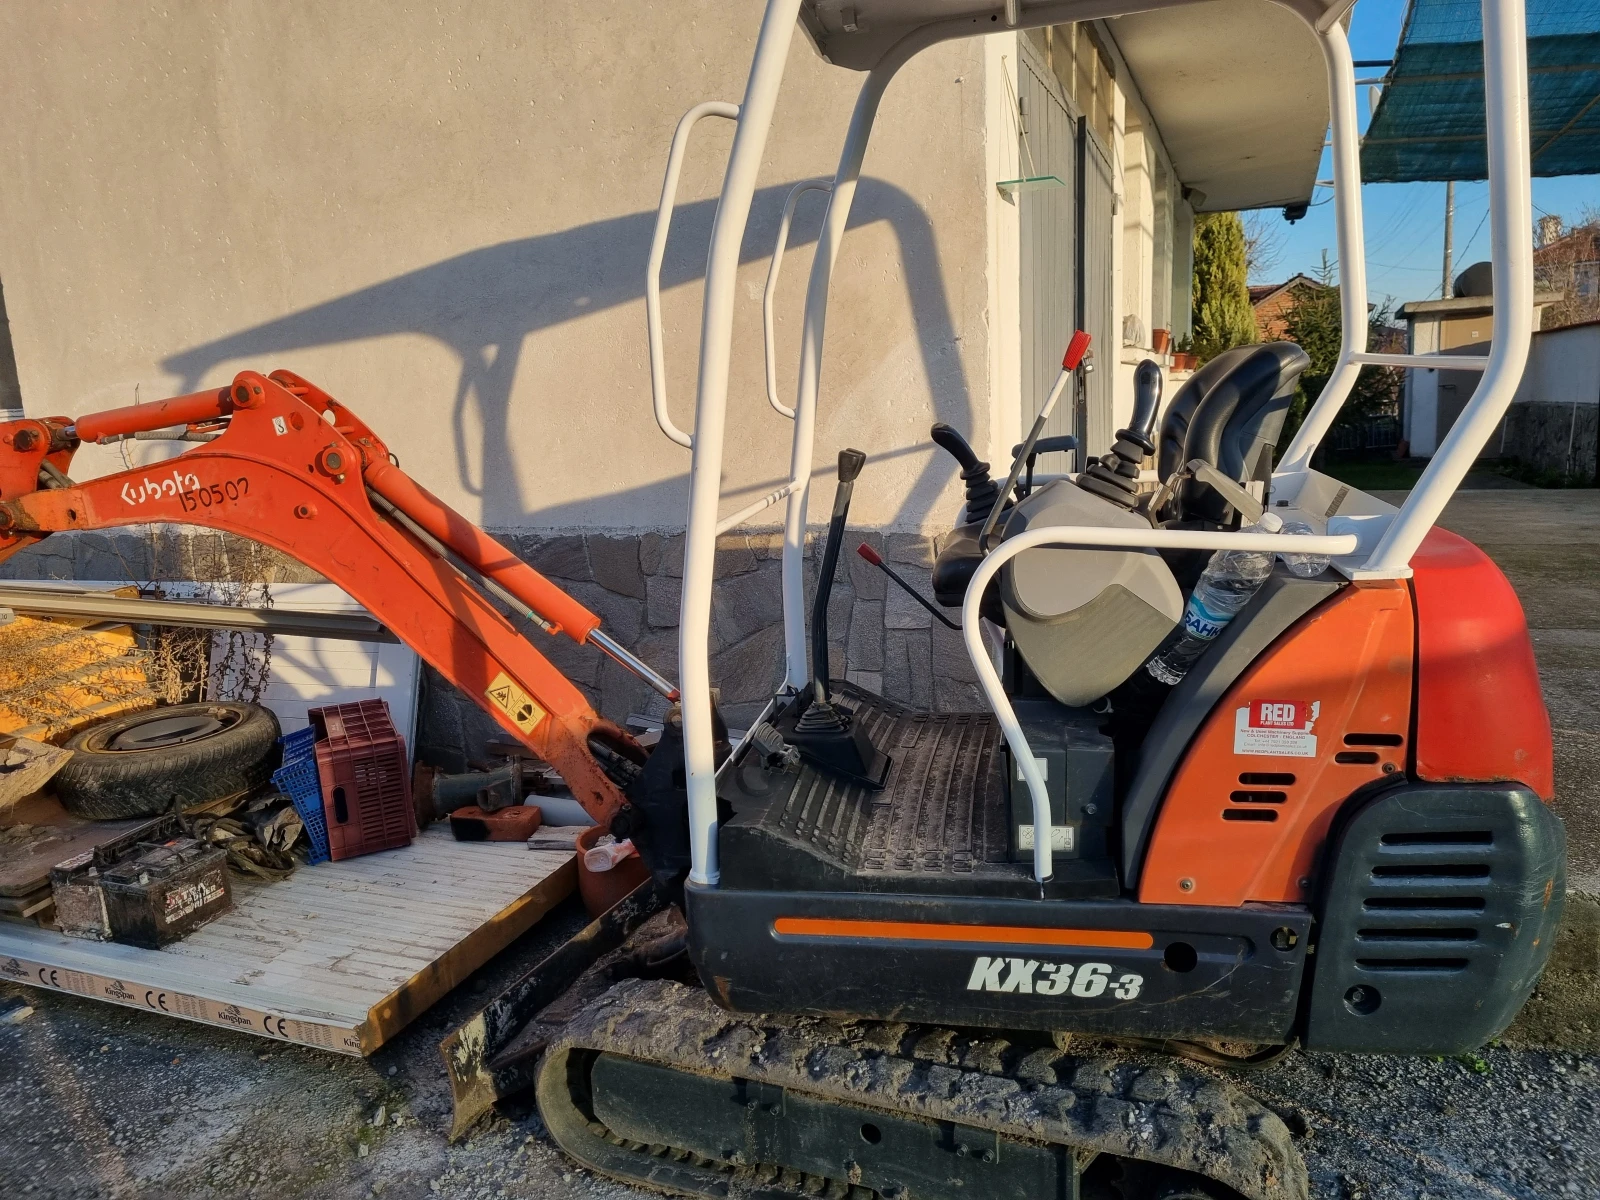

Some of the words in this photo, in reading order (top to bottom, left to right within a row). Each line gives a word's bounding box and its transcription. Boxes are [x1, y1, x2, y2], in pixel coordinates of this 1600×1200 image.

[121, 471, 200, 505] Kubota
[1260, 703, 1296, 722] RED
[39, 967, 60, 987] CE
[967, 956, 1144, 1000] KX36-3
[104, 986, 135, 1000] Kingspan
[145, 991, 169, 1012] CE
[218, 1011, 252, 1026] Kingspan
[263, 1015, 289, 1038] CE
